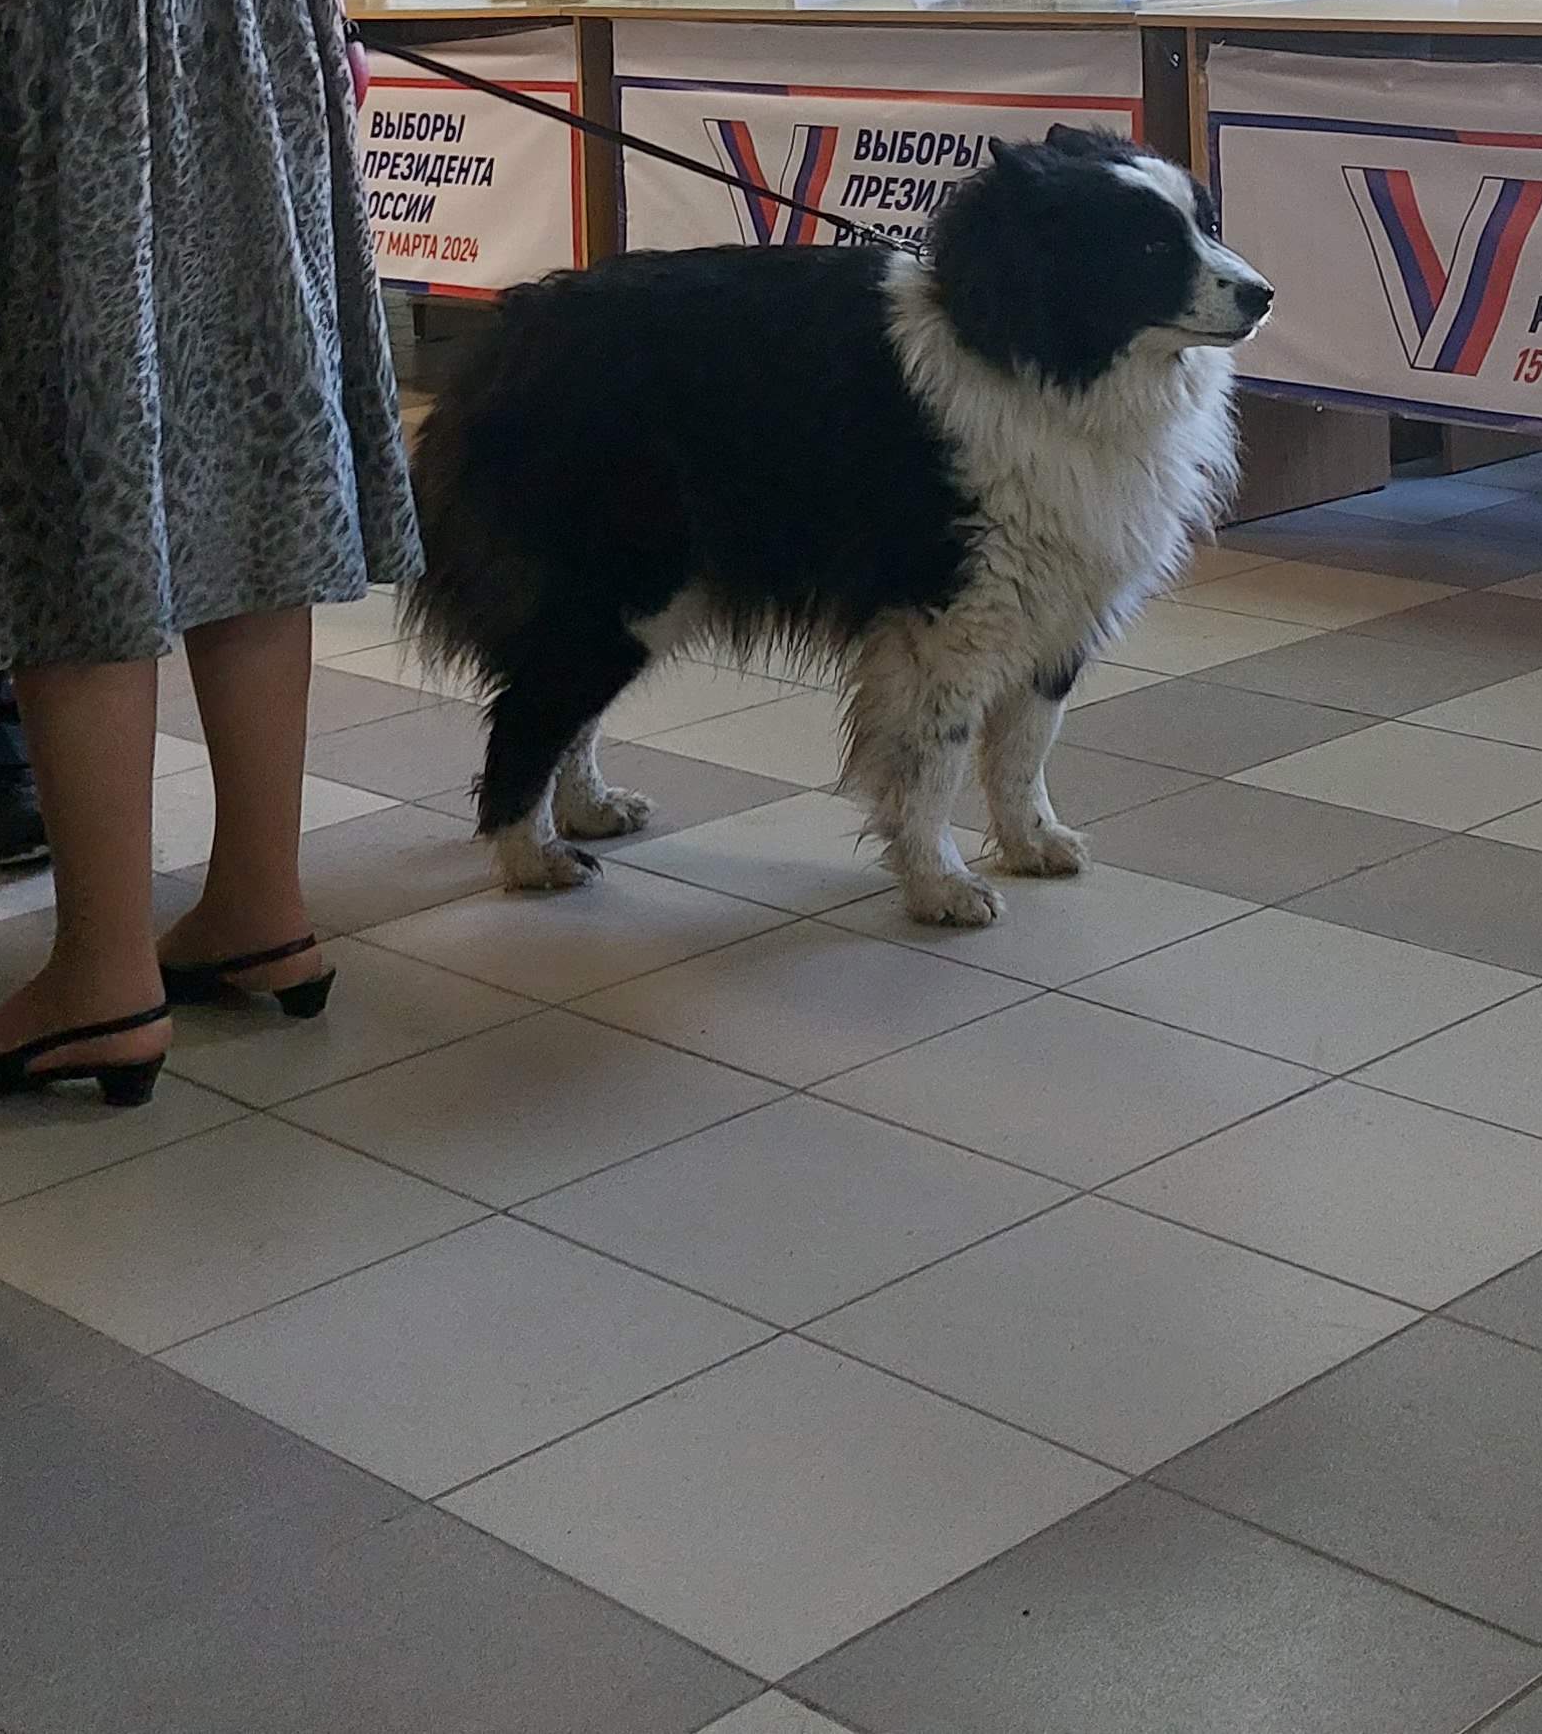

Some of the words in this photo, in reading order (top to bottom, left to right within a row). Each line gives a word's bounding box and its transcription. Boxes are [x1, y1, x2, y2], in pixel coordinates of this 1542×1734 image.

[370, 110, 466, 143] ВЫБОРЫ
[854, 128, 984, 168] ВЫБОРЫ
[363, 150, 495, 188] ПРЕЗИДЕНТА
[368, 190, 437, 224] ОССИИ
[386, 231, 438, 259] МАРТА
[441, 235, 479, 263] 2024
